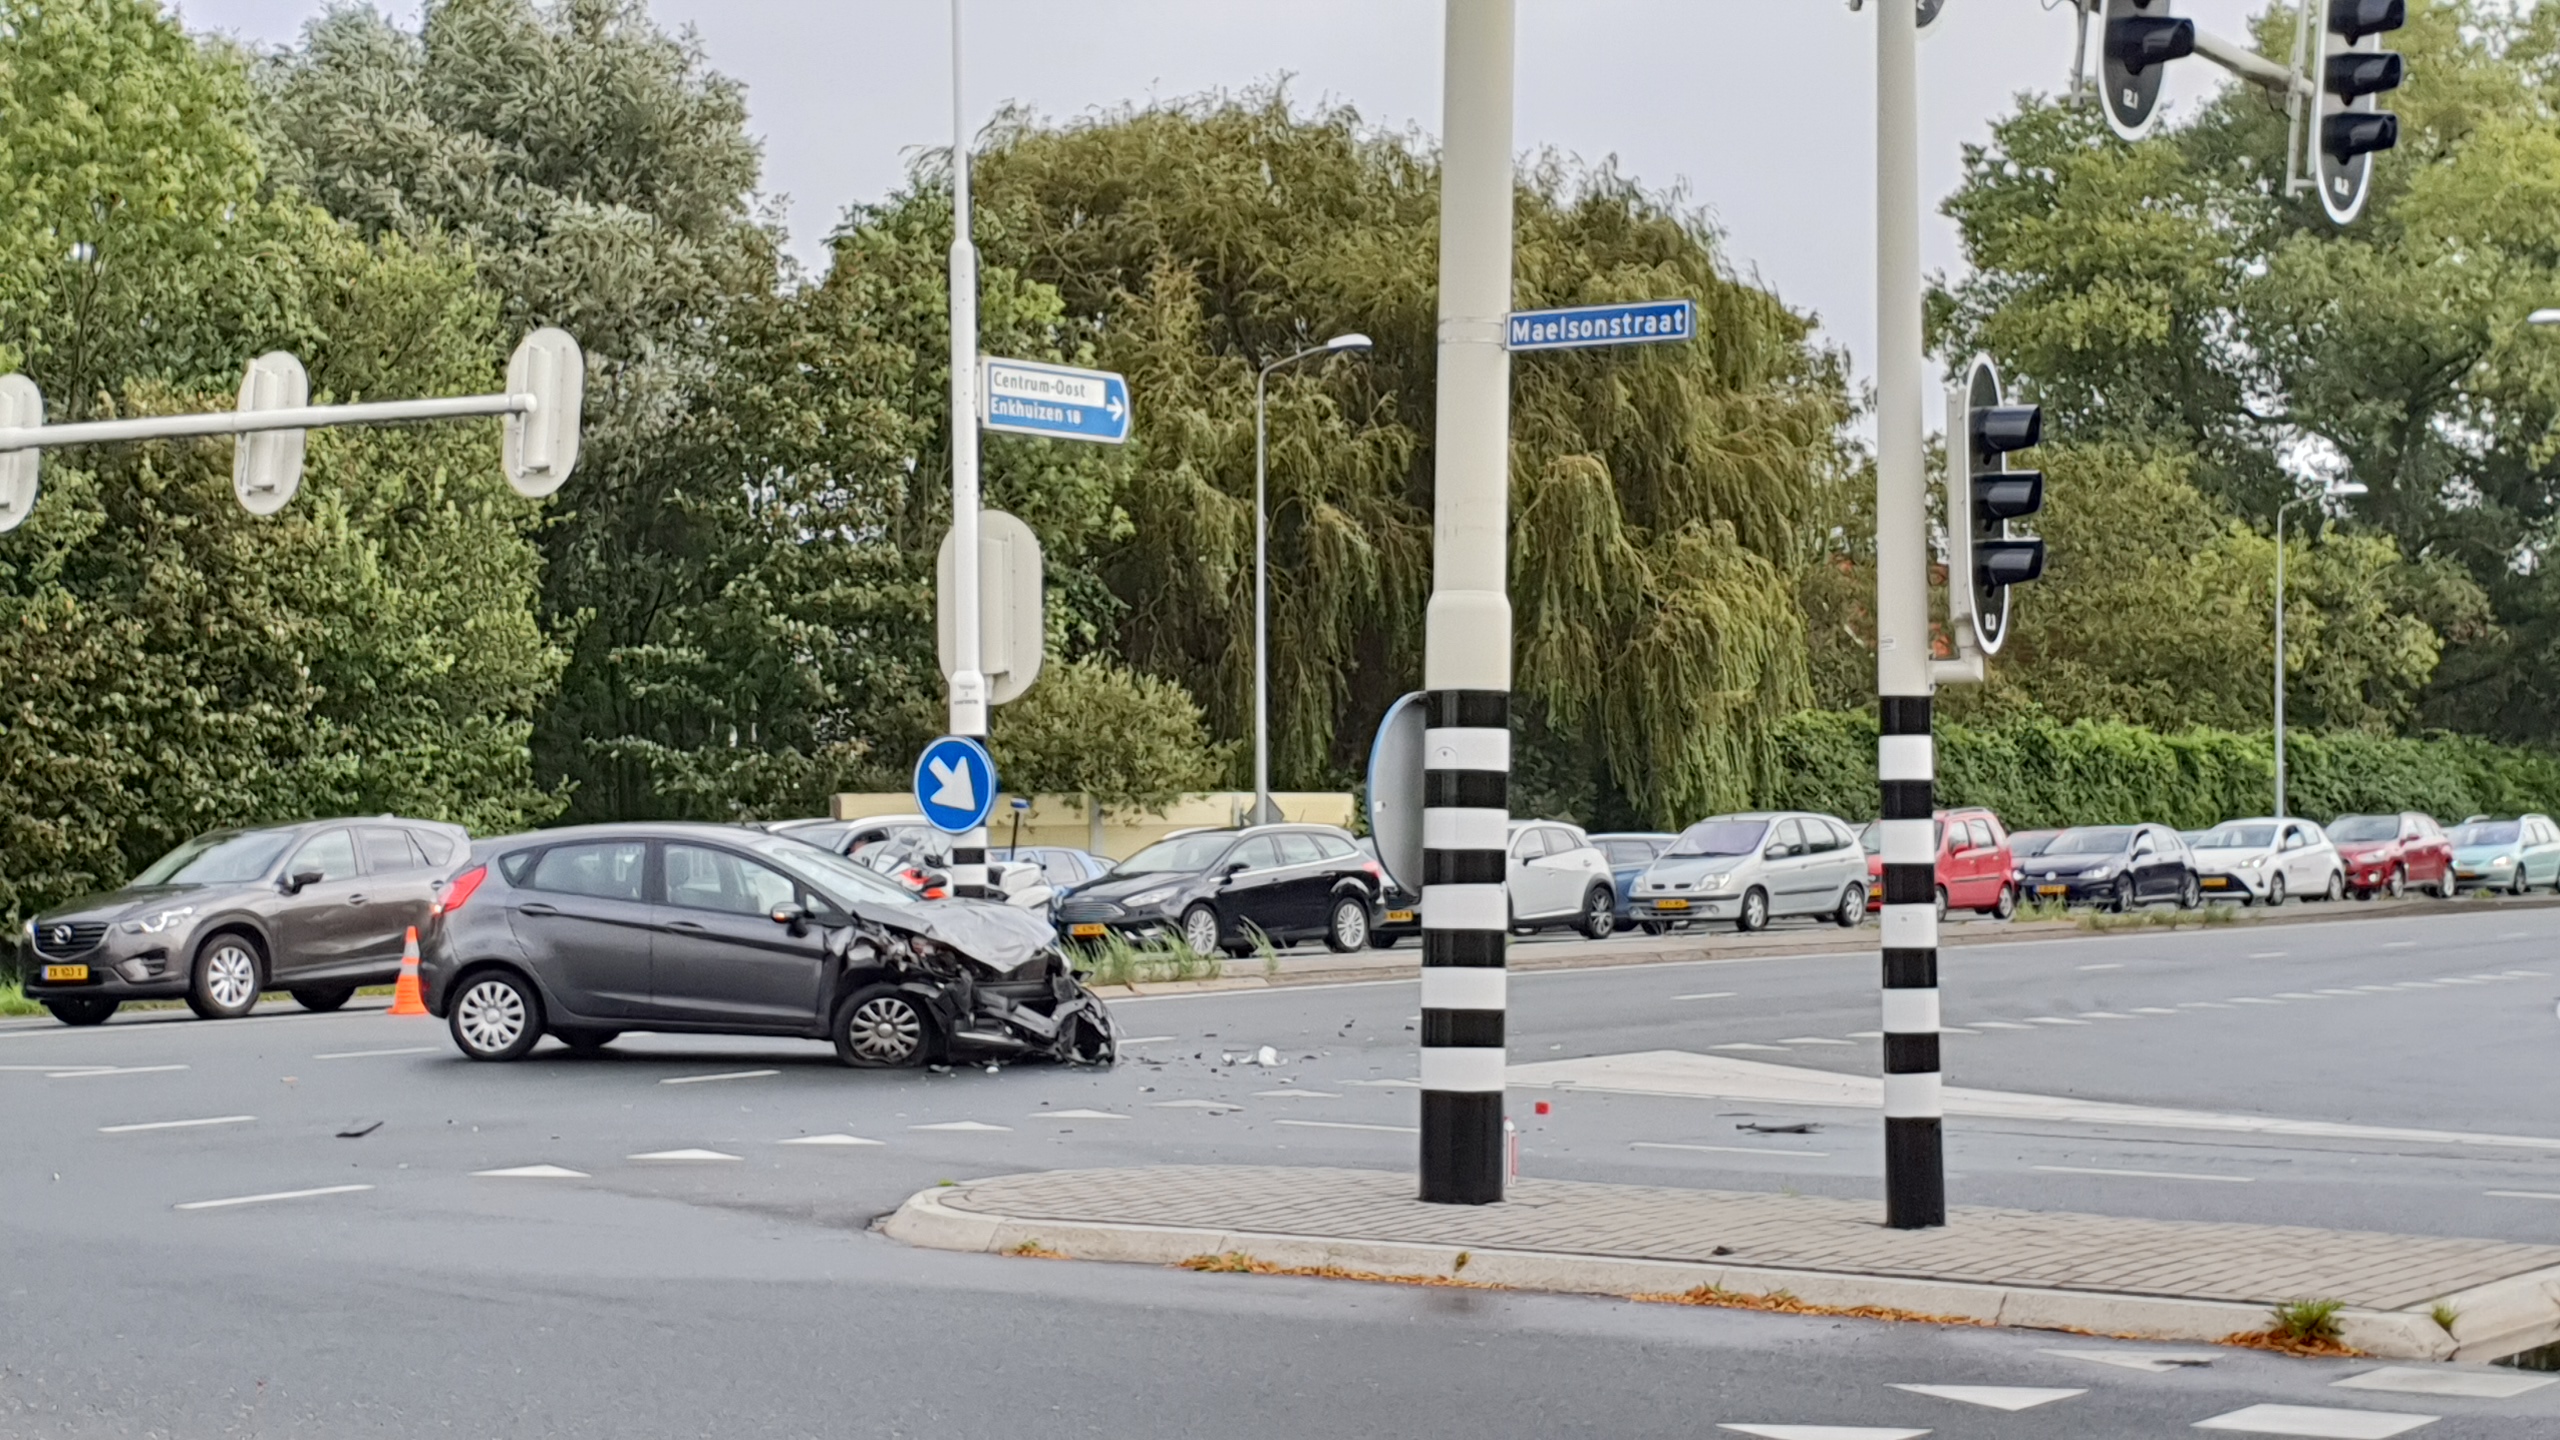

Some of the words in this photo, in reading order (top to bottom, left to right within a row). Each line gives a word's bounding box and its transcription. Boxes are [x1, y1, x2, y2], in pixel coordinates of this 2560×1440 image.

[1512, 309, 1683, 343] Maelsonstraat
[993, 371, 1086, 398] Centrum-Oost
[991, 397, 1063, 420] Enkhuizen
